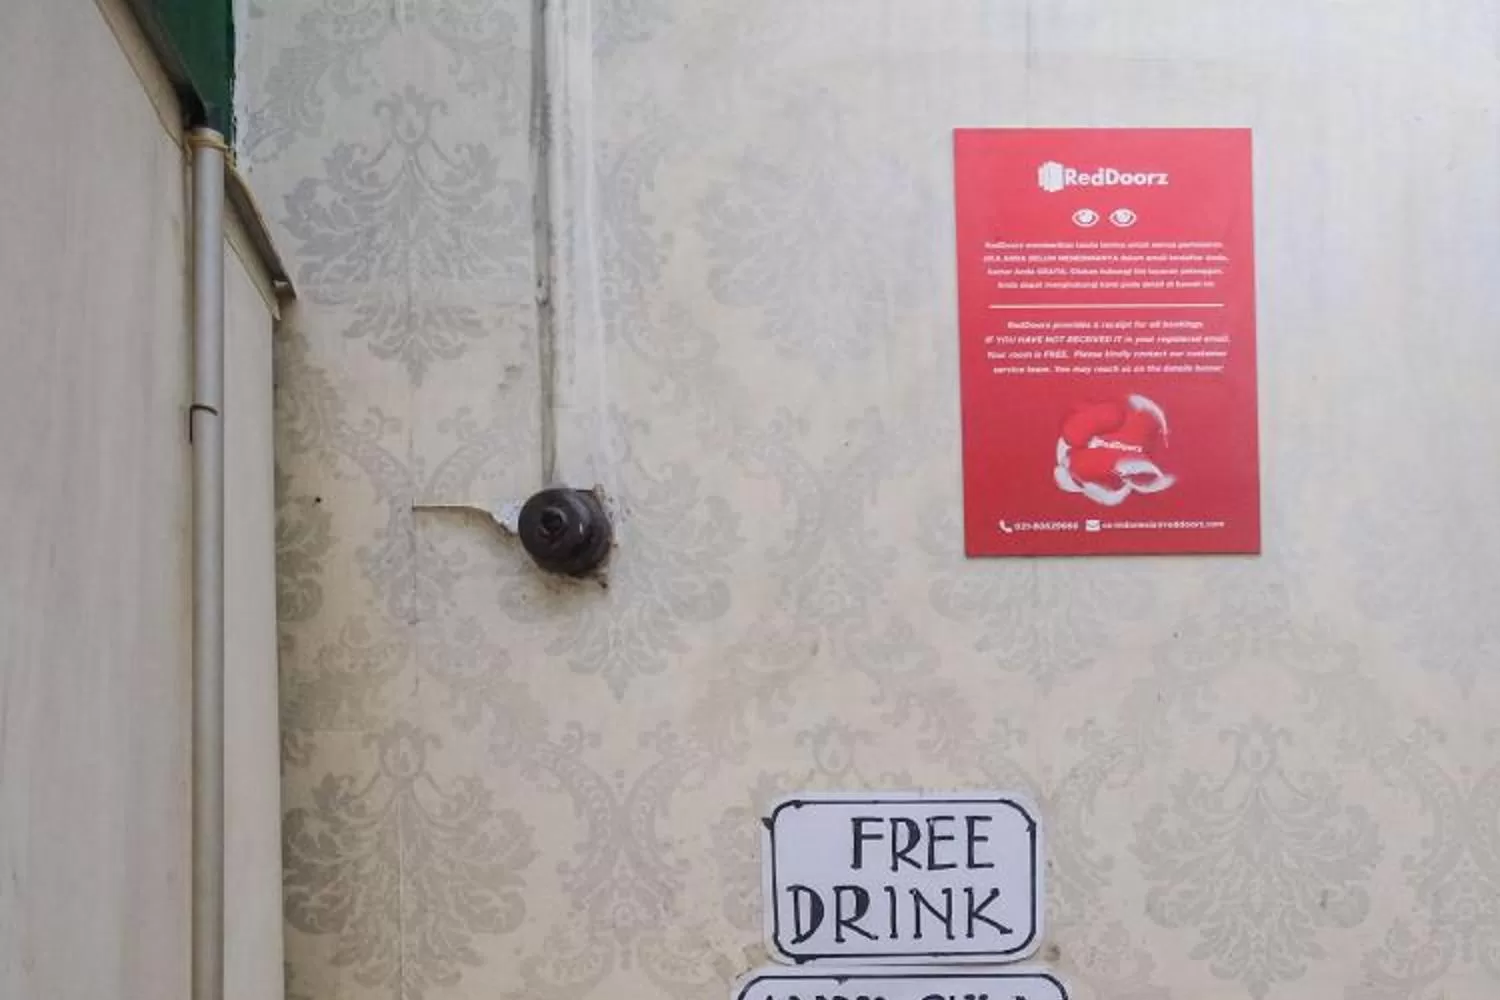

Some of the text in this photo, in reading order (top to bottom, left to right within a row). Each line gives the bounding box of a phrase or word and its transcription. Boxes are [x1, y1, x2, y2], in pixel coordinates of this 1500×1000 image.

[1065, 167, 1168, 186] RedDoorz
[850, 815, 995, 872] FREE
[786, 884, 1013, 945] DRINK
